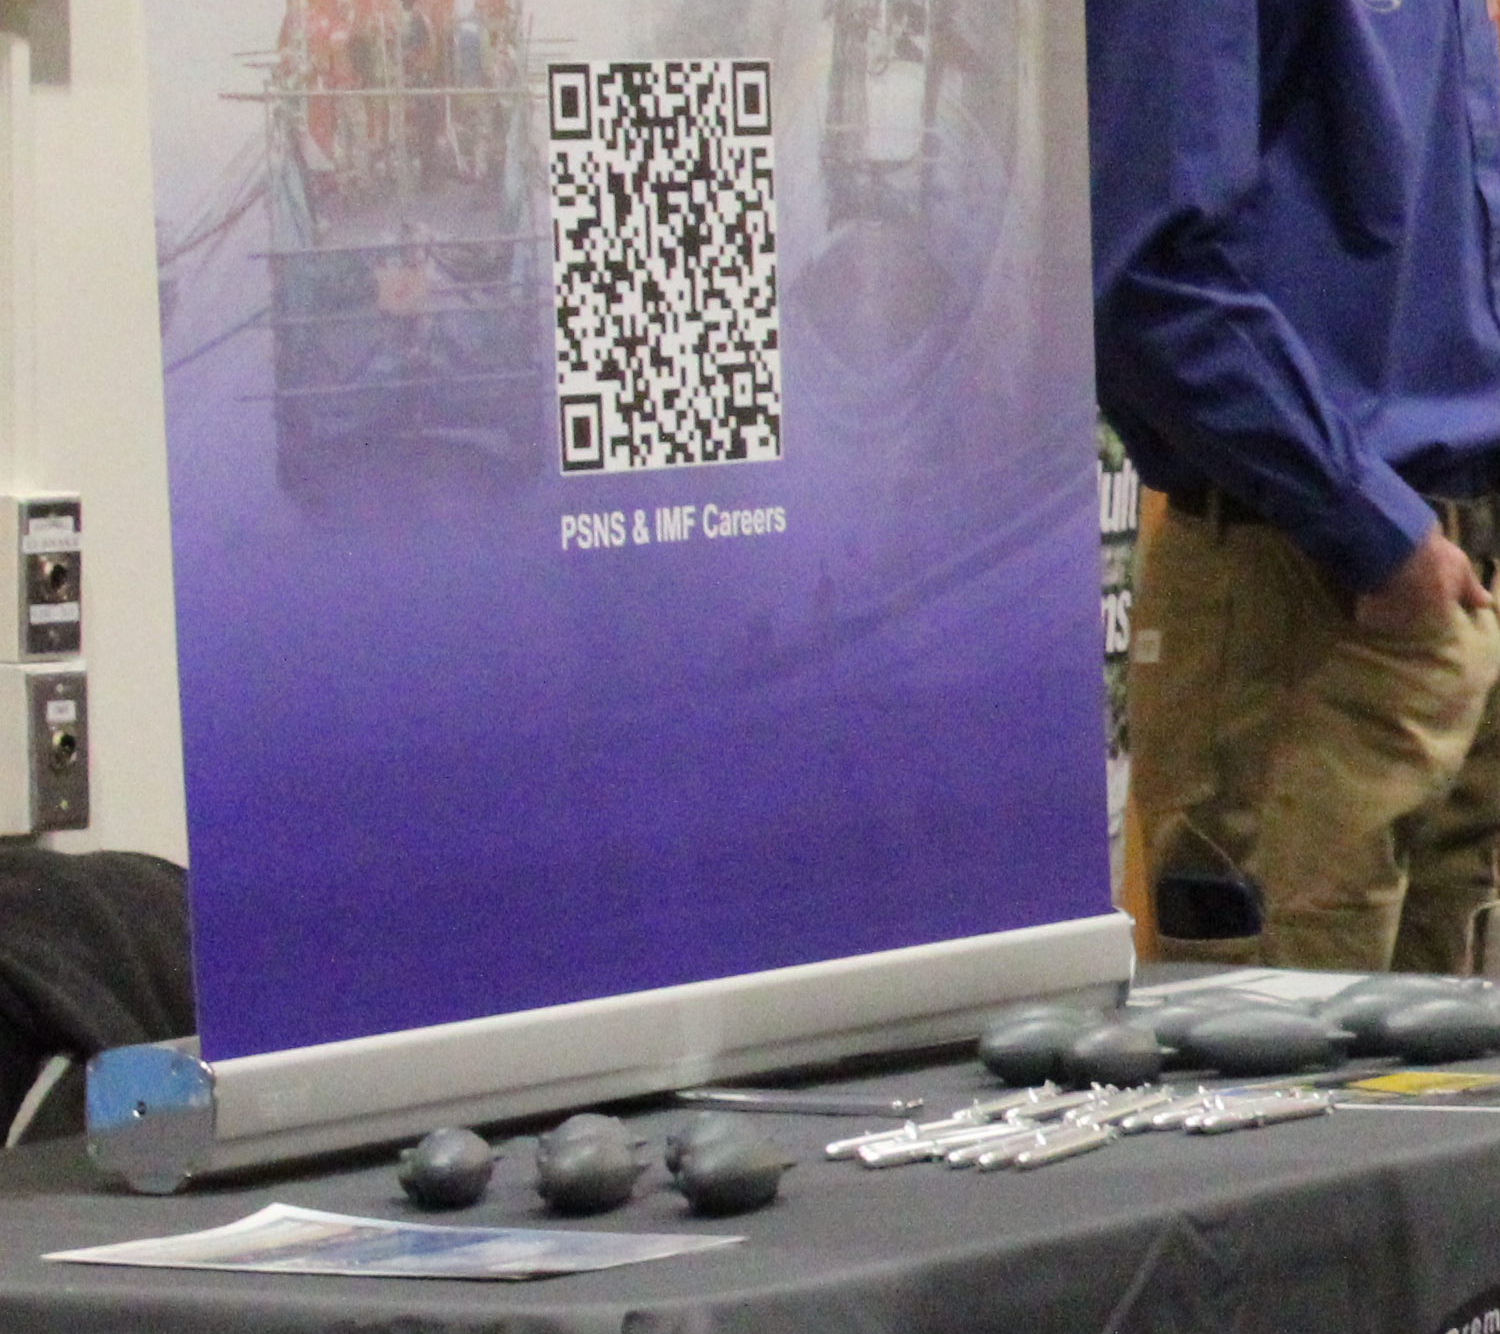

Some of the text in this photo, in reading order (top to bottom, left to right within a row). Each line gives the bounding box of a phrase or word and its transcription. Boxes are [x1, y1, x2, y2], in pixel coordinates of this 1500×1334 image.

[560, 503, 787, 551] PSNS & IMF Careers
